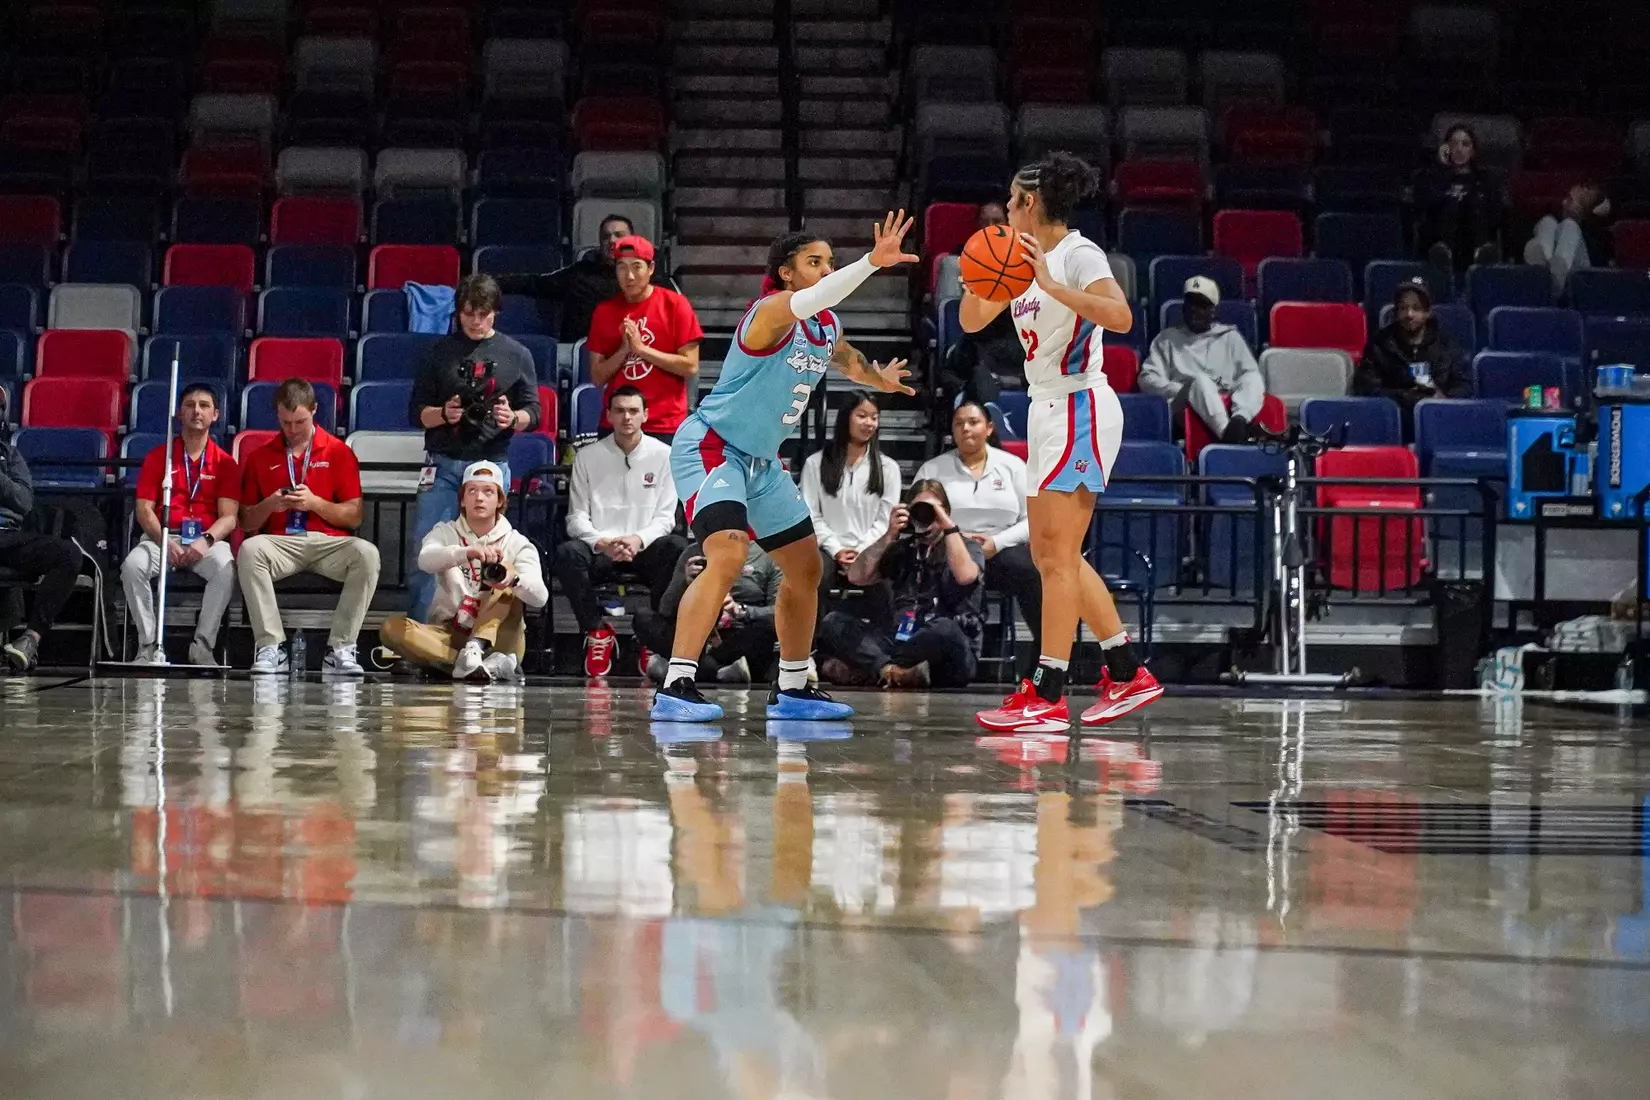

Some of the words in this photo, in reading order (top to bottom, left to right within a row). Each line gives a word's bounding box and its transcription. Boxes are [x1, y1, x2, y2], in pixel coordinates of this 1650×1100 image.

[1013, 297, 1041, 321] Liberty
[782, 383, 811, 425] 3
[1611, 410, 1621, 485] POWERADE
